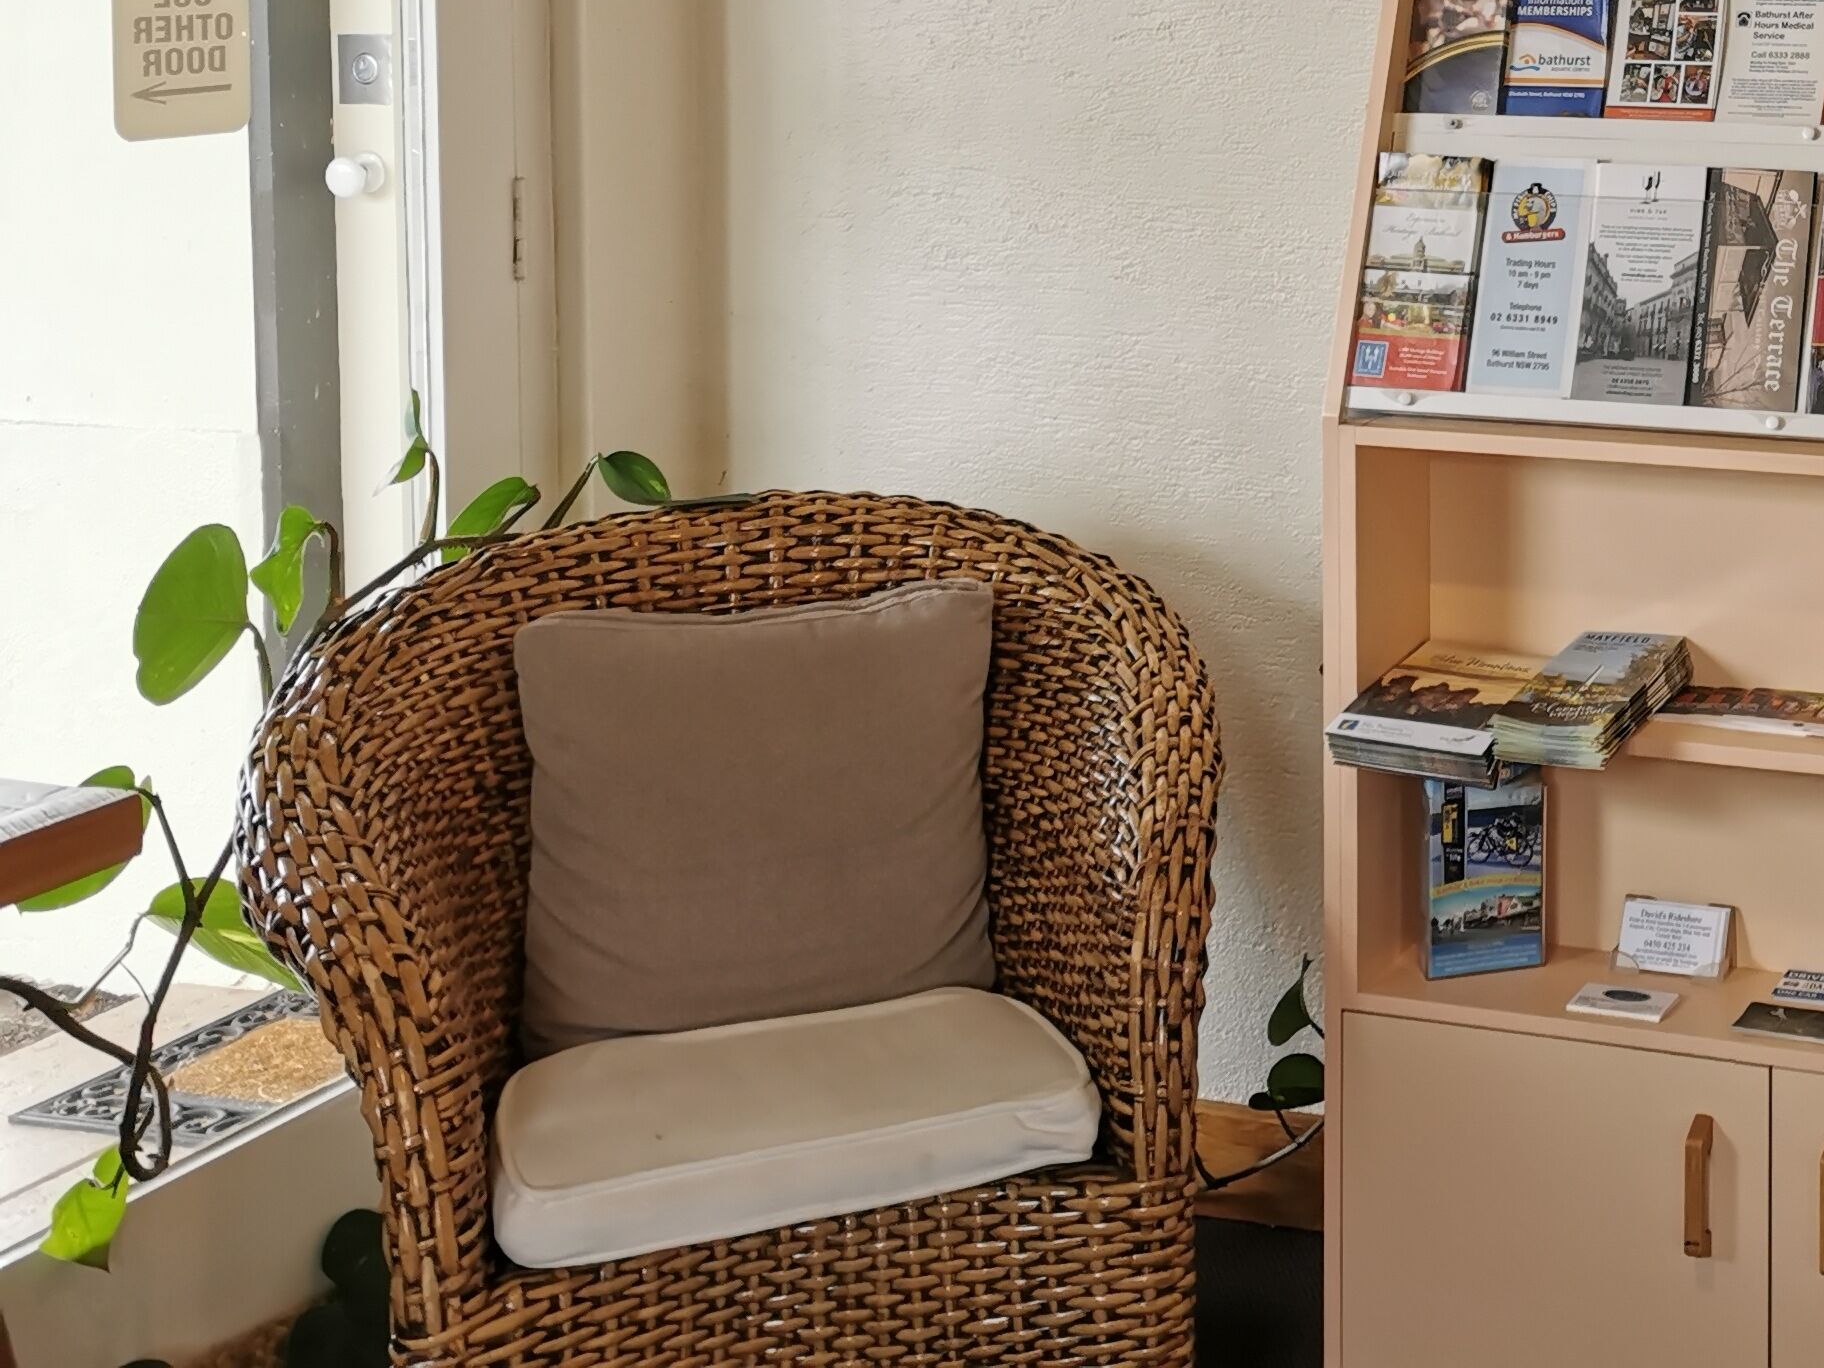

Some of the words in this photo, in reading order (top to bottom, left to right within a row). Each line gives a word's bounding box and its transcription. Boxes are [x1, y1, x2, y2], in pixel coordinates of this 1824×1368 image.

[1517, 6, 1593, 16] MEMBERSHIPS
[1755, 11, 1791, 19] Bathurst
[1793, 11, 1814, 19] After
[1754, 22, 1780, 30] Hours
[1782, 22, 1814, 30] Medical
[1753, 32, 1785, 40] Service
[1538, 54, 1591, 66] bathurst
[1506, 258, 1532, 269] Trading
[1534, 259, 1556, 268] Hours
[1771, 238, 1799, 287] The
[1510, 302, 1542, 313] Telephone
[1490, 313, 1502, 322] 02
[1506, 314, 1529, 323] 6331
[1764, 295, 1793, 393] Terrace
[1583, 633, 1651, 645] MAYFIELD
